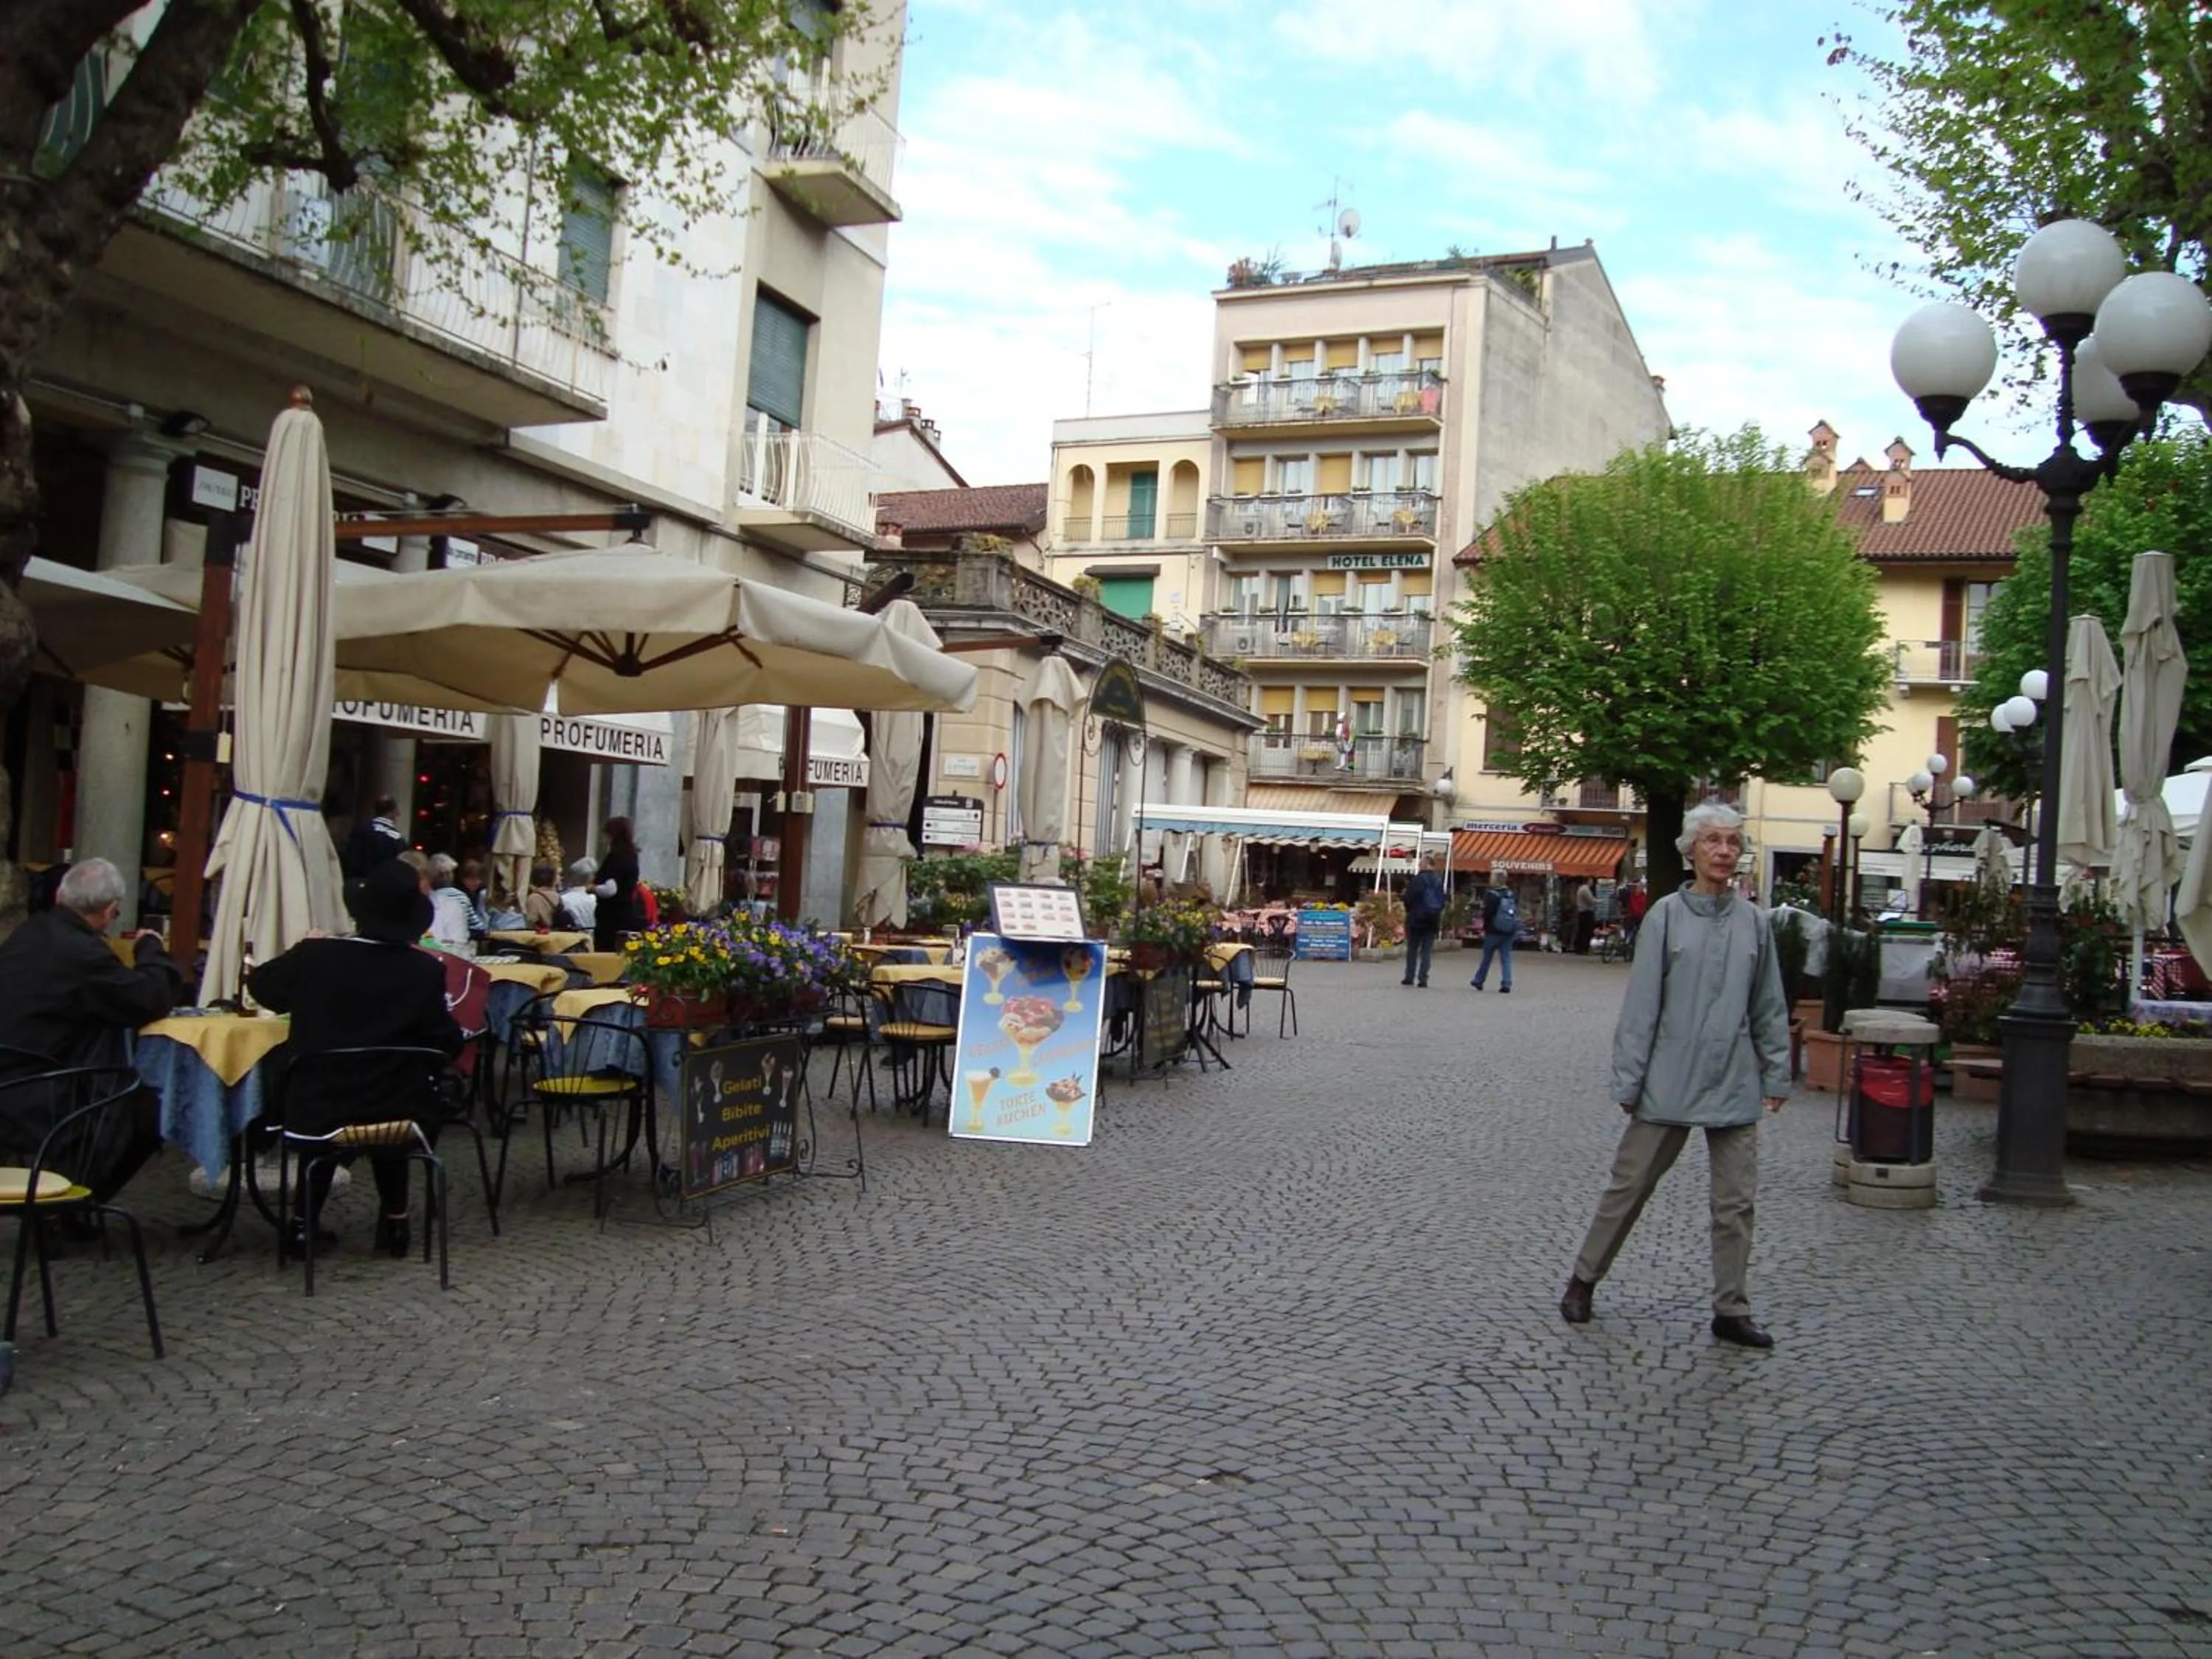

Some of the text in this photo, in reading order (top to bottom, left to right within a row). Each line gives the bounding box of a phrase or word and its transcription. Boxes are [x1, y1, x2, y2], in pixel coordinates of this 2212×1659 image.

[1332, 554, 1425, 567] HOTEL ELENA
[332, 700, 475, 734] OFUMERIA
[540, 717, 665, 760] PROFUMERIA
[1467, 822, 1517, 831] merceria
[1490, 860, 1553, 871] SOUVENIRS
[722, 1076, 762, 1094] Gelati
[1000, 1091, 1036, 1111] TORTE
[722, 1103, 762, 1121] Bibite
[997, 1102, 1046, 1128] KUCHEN
[712, 1124, 771, 1152] Aperitivi
